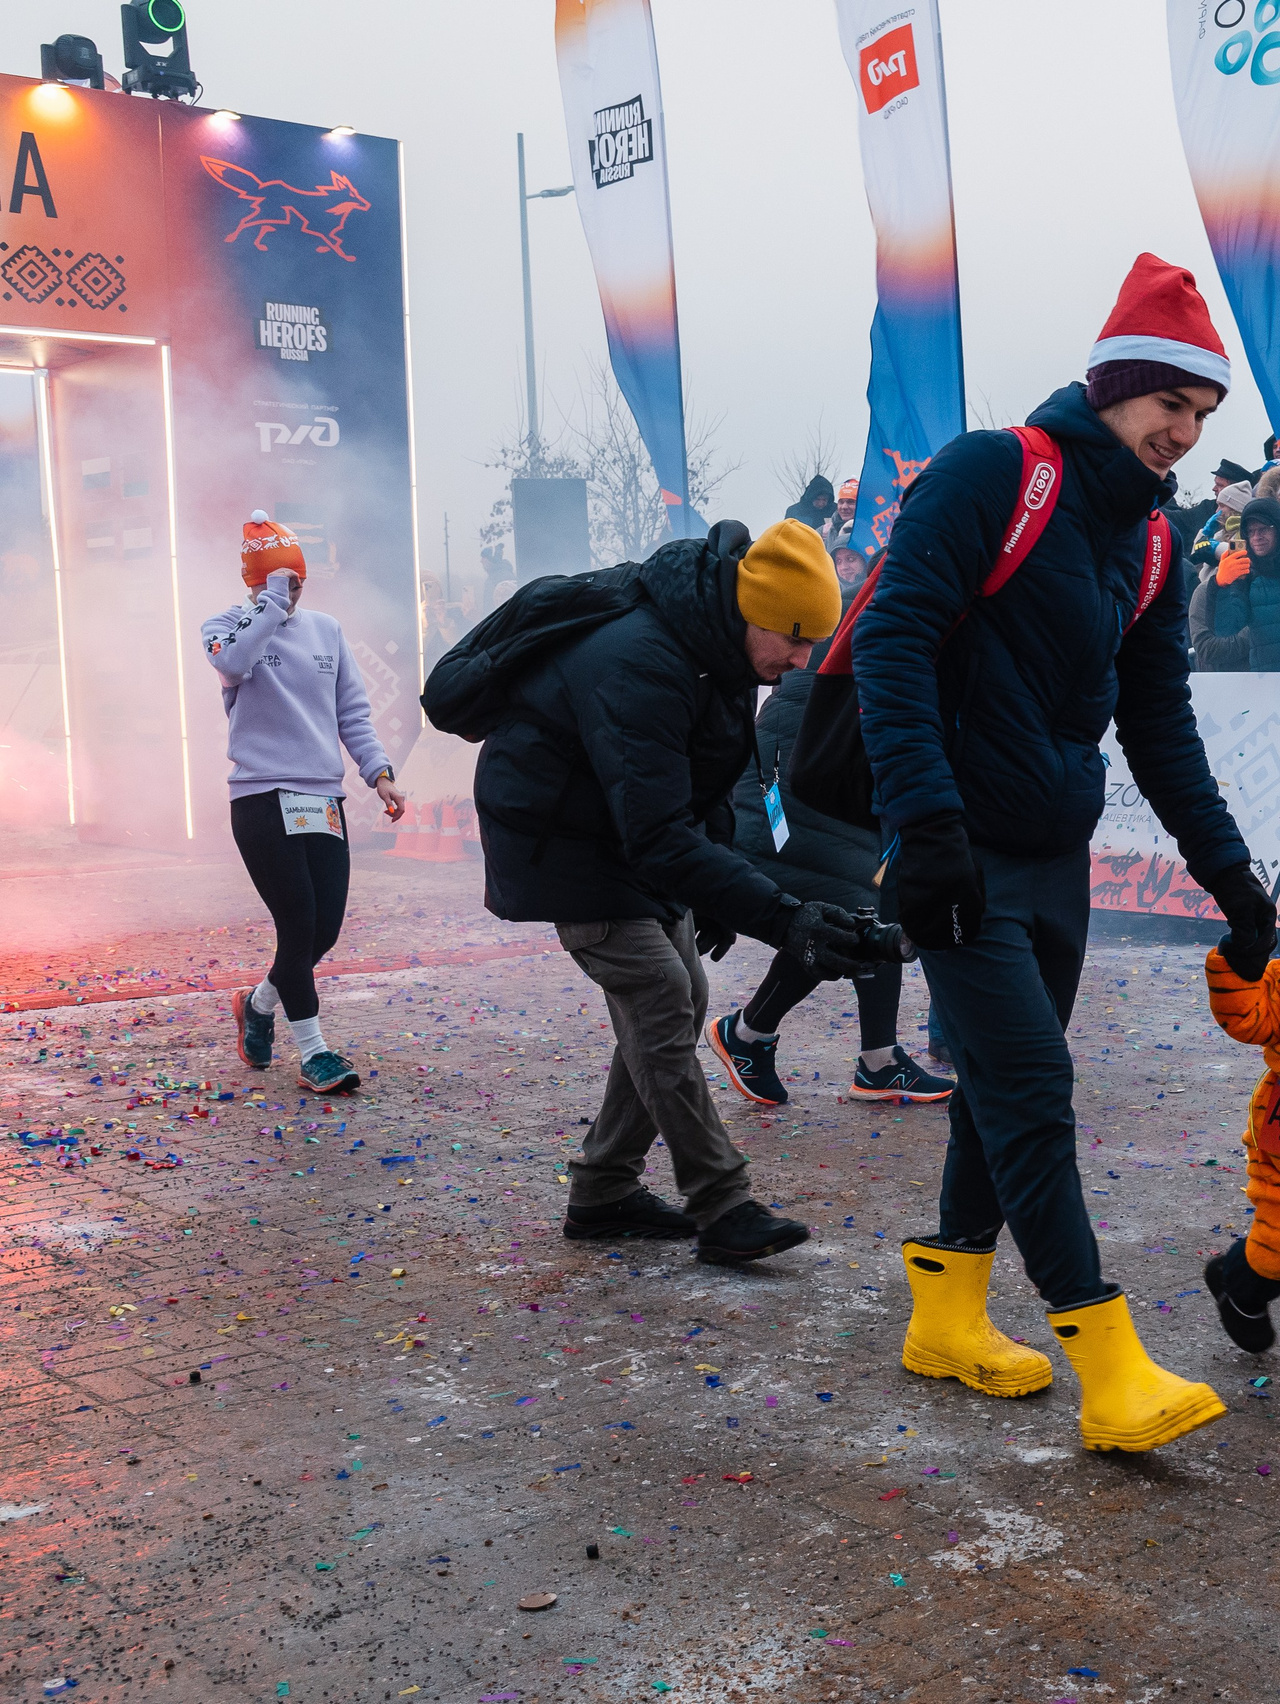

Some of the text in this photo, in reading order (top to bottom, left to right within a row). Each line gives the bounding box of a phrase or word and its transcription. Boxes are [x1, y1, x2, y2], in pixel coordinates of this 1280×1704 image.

[265, 302, 320, 326] RUNNING
[259, 319, 328, 352] HEROES
[280, 347, 309, 361] RUSSIA
[1029, 468, 1050, 503] T100
[1003, 510, 1031, 554] Finisher
[1152, 535, 1160, 563] RING
[1154, 553, 1163, 580] TRAIL
